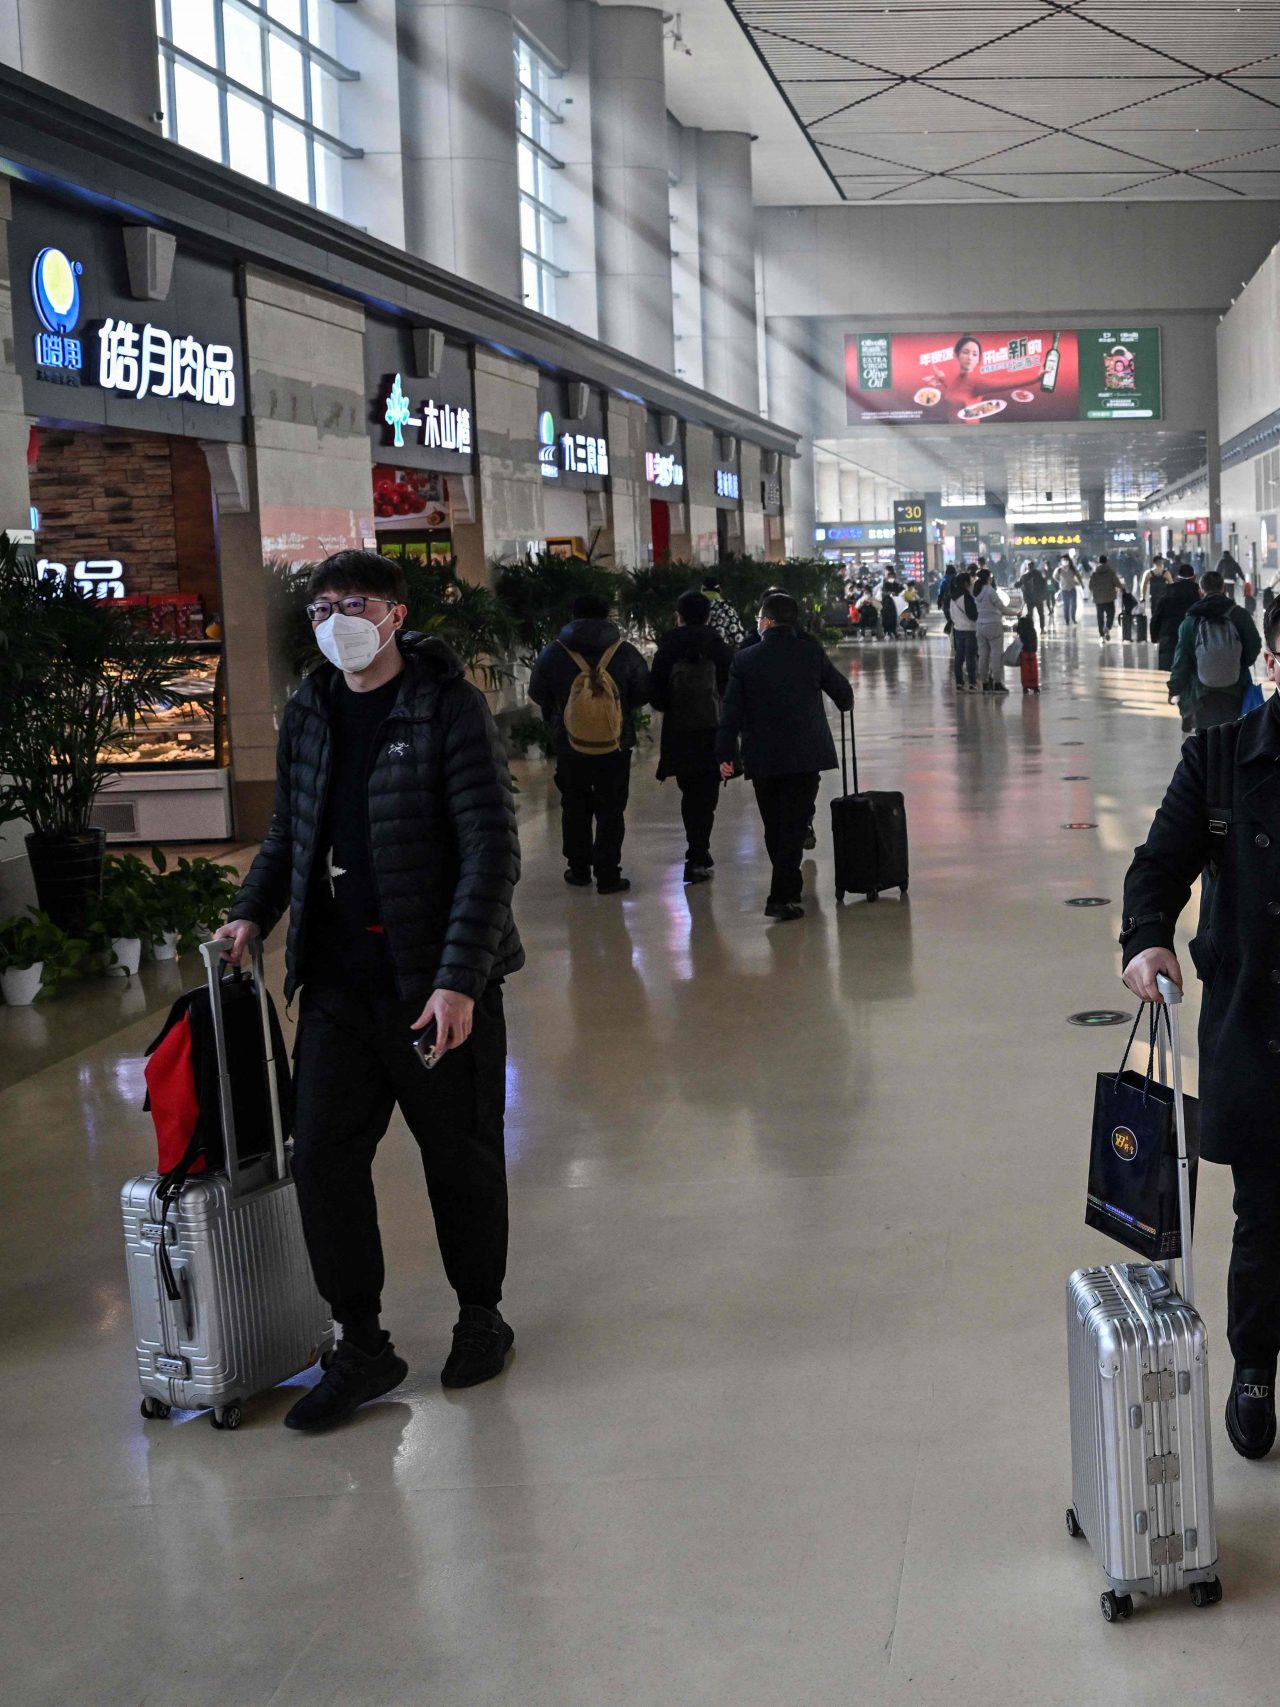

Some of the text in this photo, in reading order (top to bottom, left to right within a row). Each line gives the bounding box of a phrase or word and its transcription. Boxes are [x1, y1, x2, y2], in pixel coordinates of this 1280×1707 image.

[36, 332, 82, 370] 皓月
[98, 318, 235, 407] 皓月肉品
[863, 367, 888, 379] Olive
[868, 377, 884, 388] Oil
[562, 432, 609, 475] 九三食品
[905, 506, 922, 519] 30
